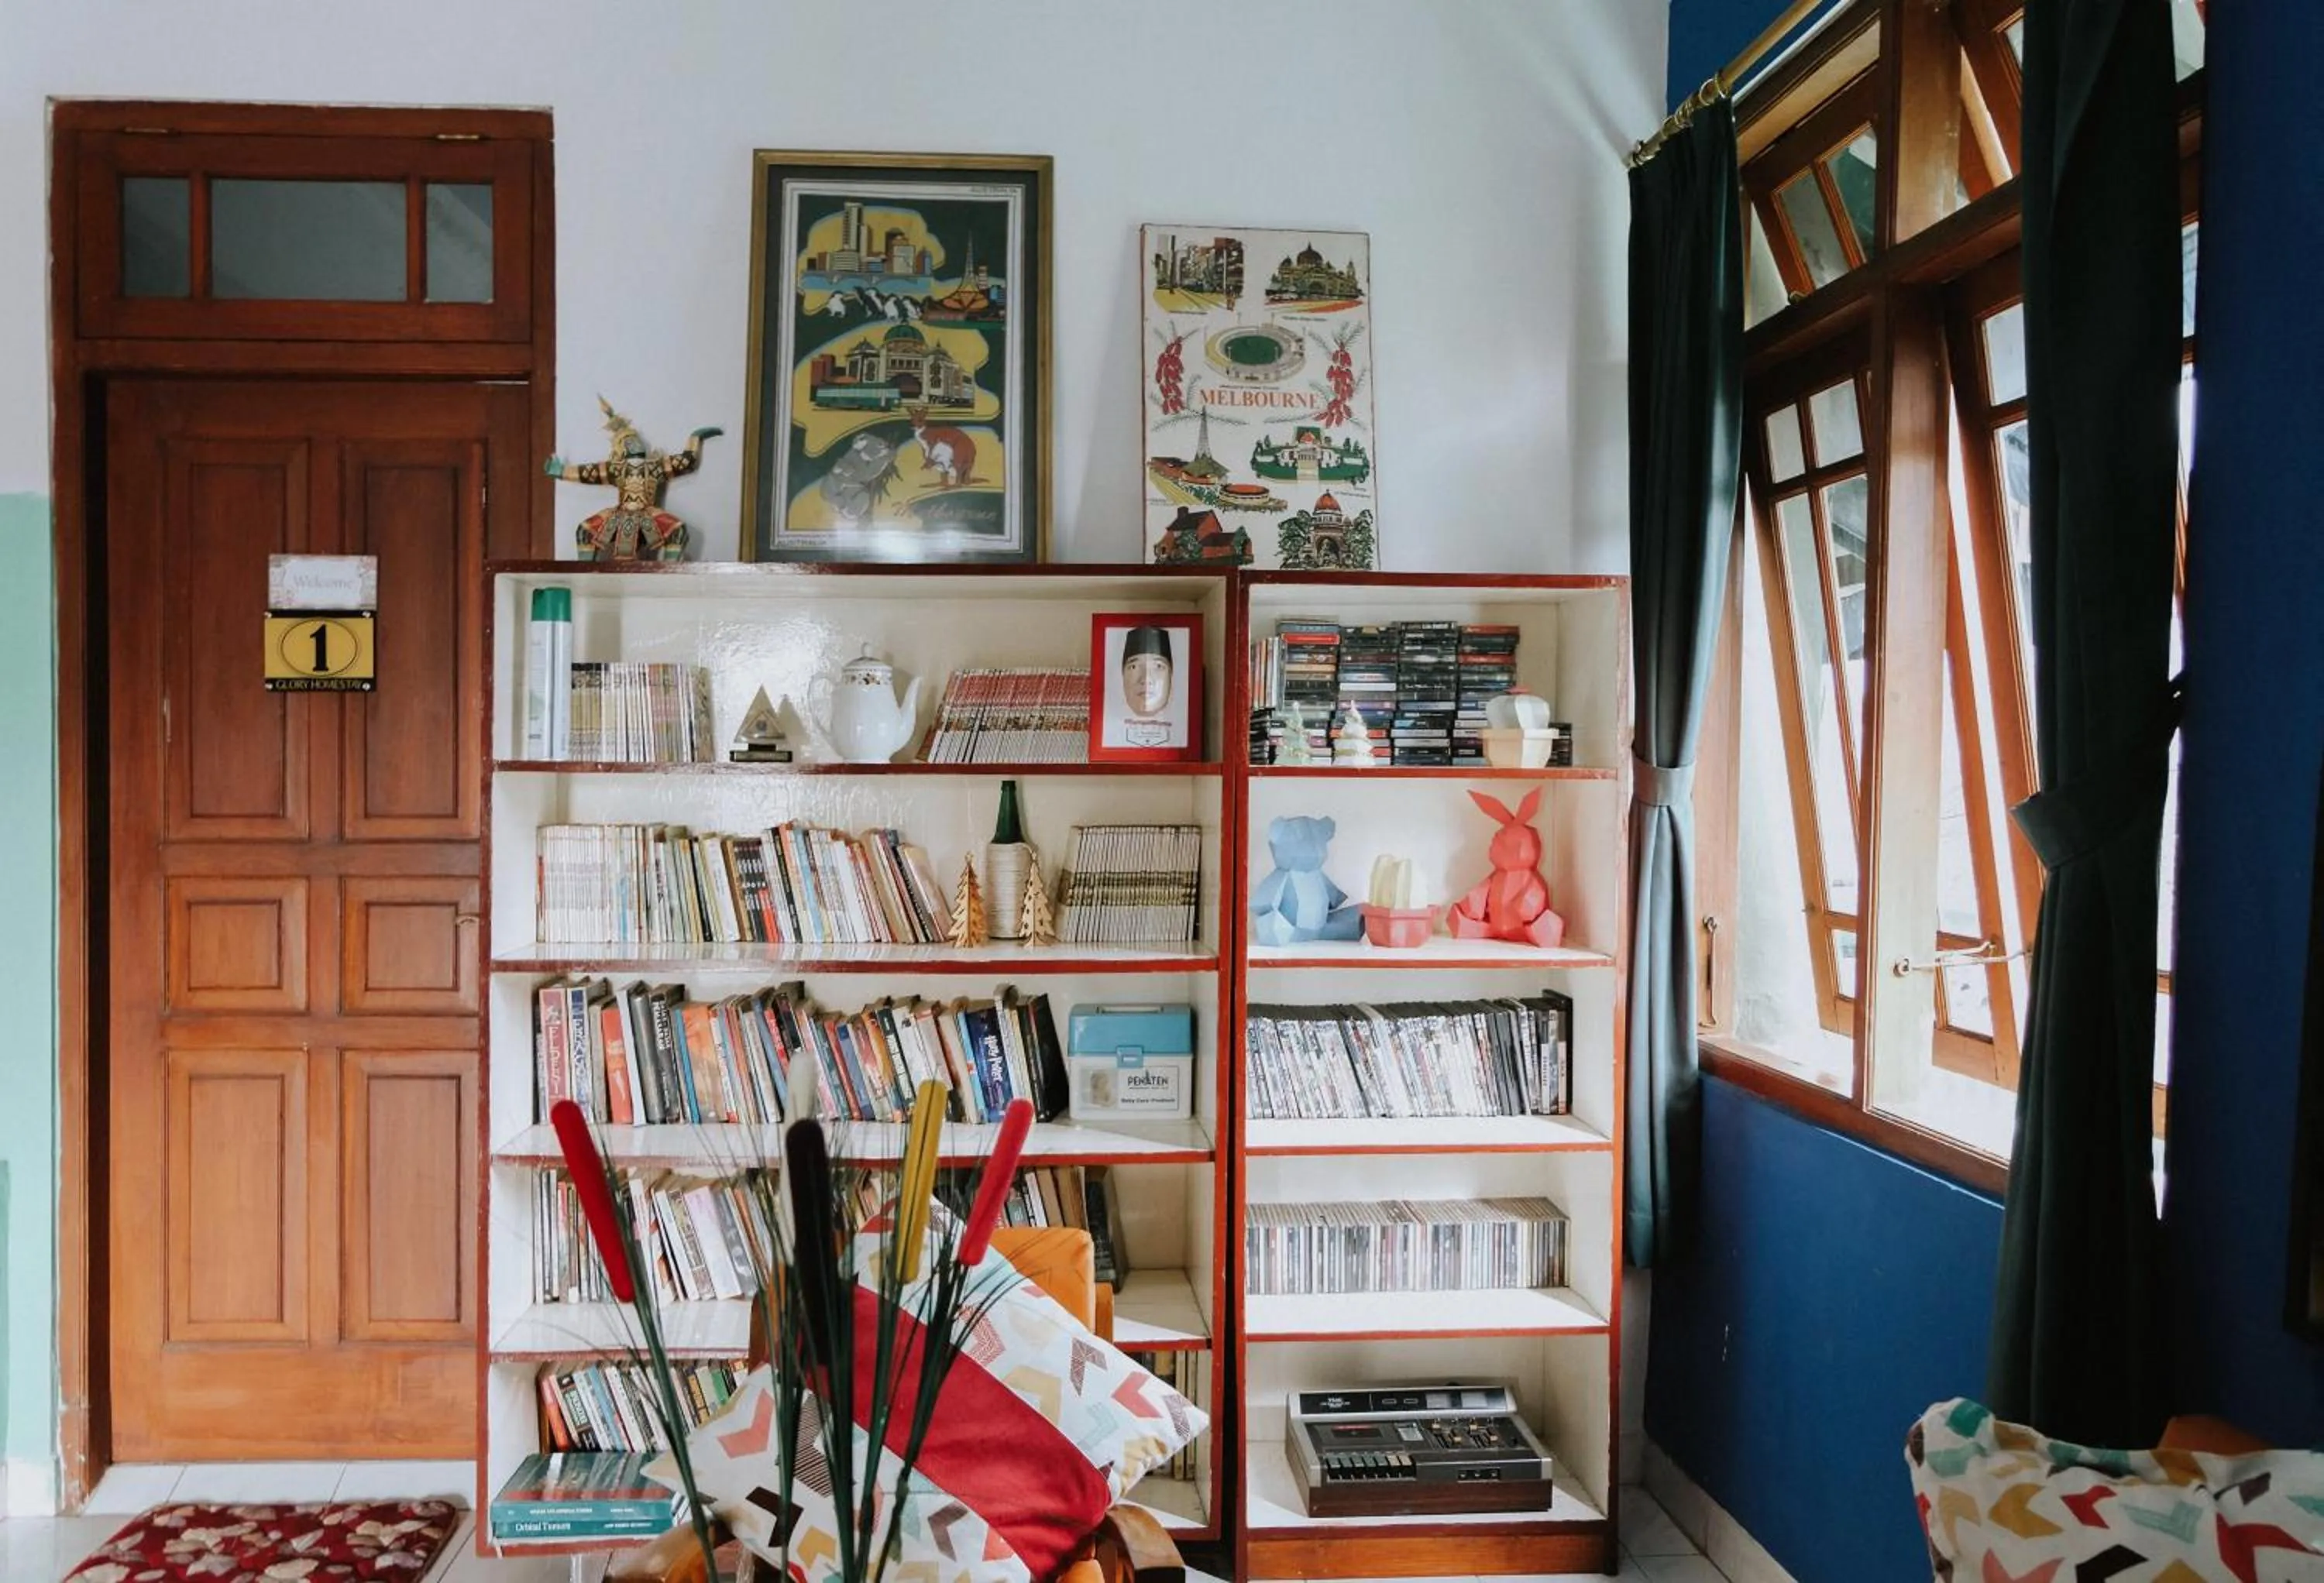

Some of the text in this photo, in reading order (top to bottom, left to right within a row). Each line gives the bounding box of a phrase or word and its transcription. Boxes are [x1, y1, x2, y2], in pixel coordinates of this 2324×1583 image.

[1200, 389, 1319, 409] MELBOURNE
[310, 623, 329, 671] 1
[276, 680, 363, 689] GLORY HOMESTAY
[988, 1056, 1003, 1082] Potter
[1127, 1069, 1169, 1086] PENATEN
